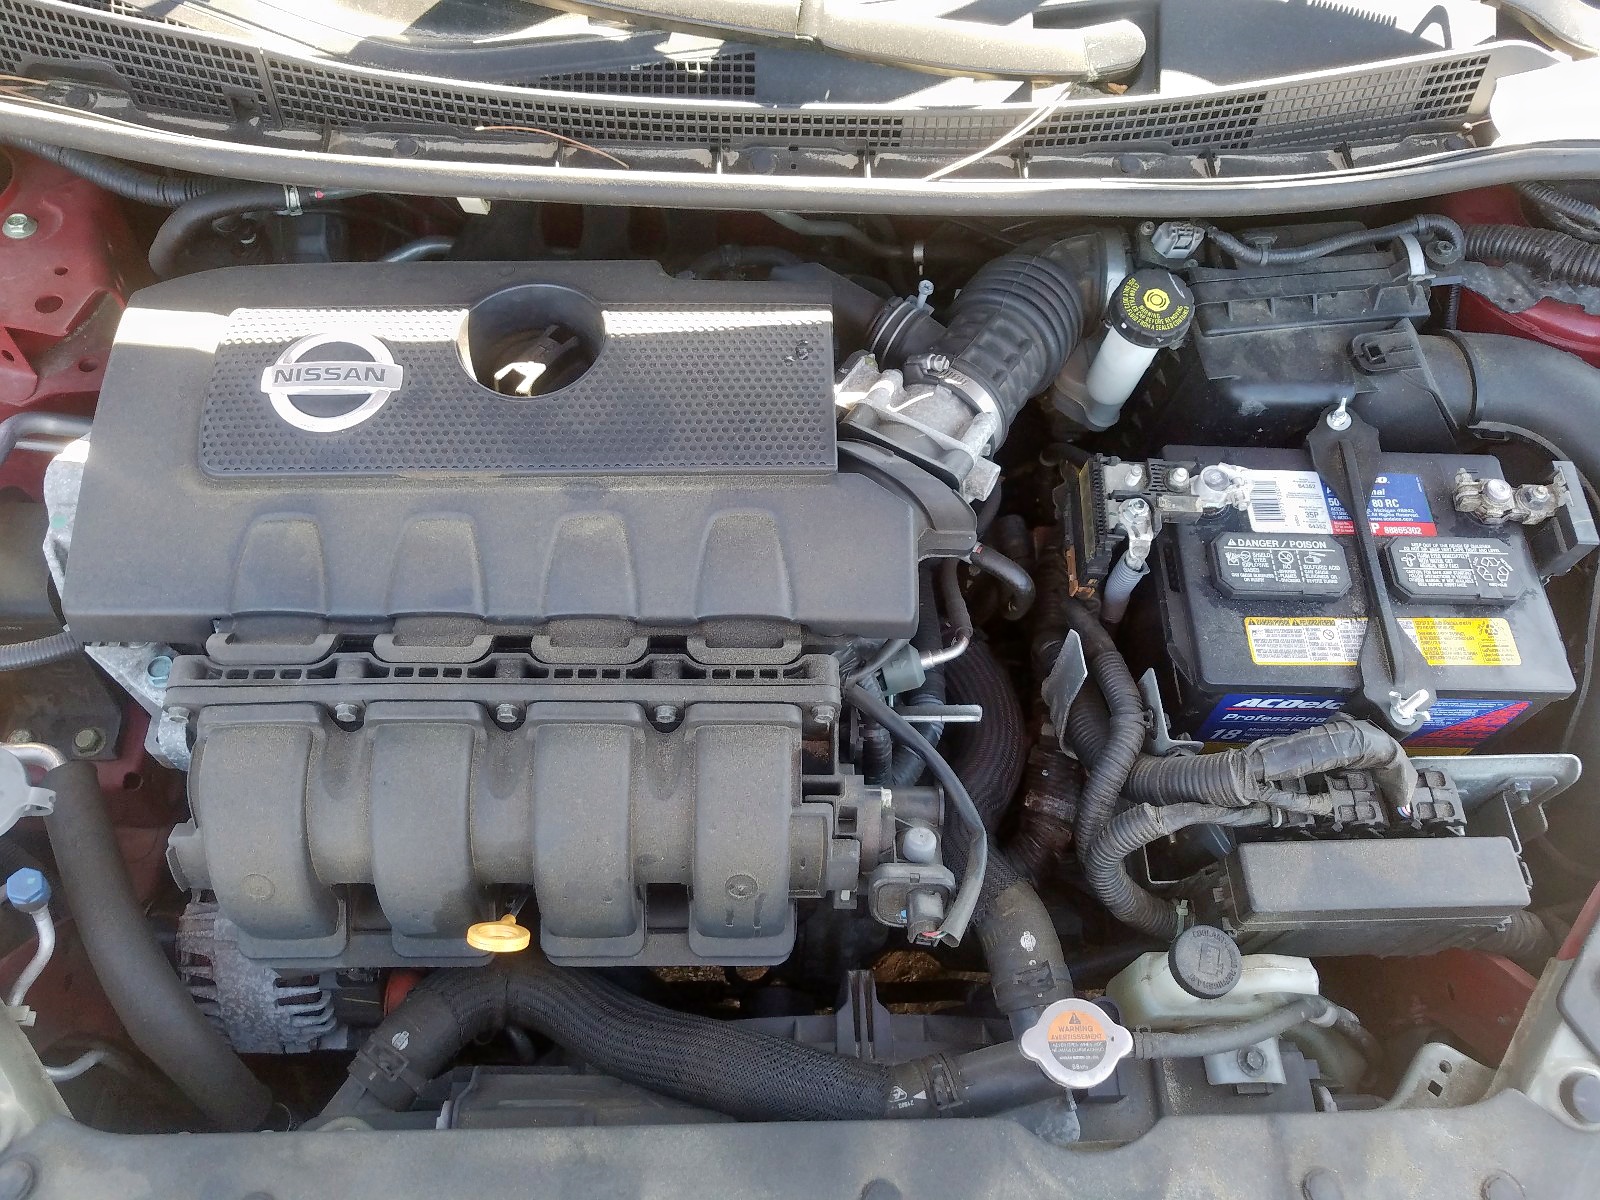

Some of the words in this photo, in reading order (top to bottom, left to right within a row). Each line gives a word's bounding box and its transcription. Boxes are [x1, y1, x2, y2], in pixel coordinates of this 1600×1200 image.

[274, 367, 386, 383] NISSAN
[1372, 499, 1383, 507] 80
[1385, 499, 1399, 507] RC
[1238, 539, 1279, 547] DANGER
[1222, 713, 1328, 722] Professiona
[1210, 729, 1242, 740] 18
